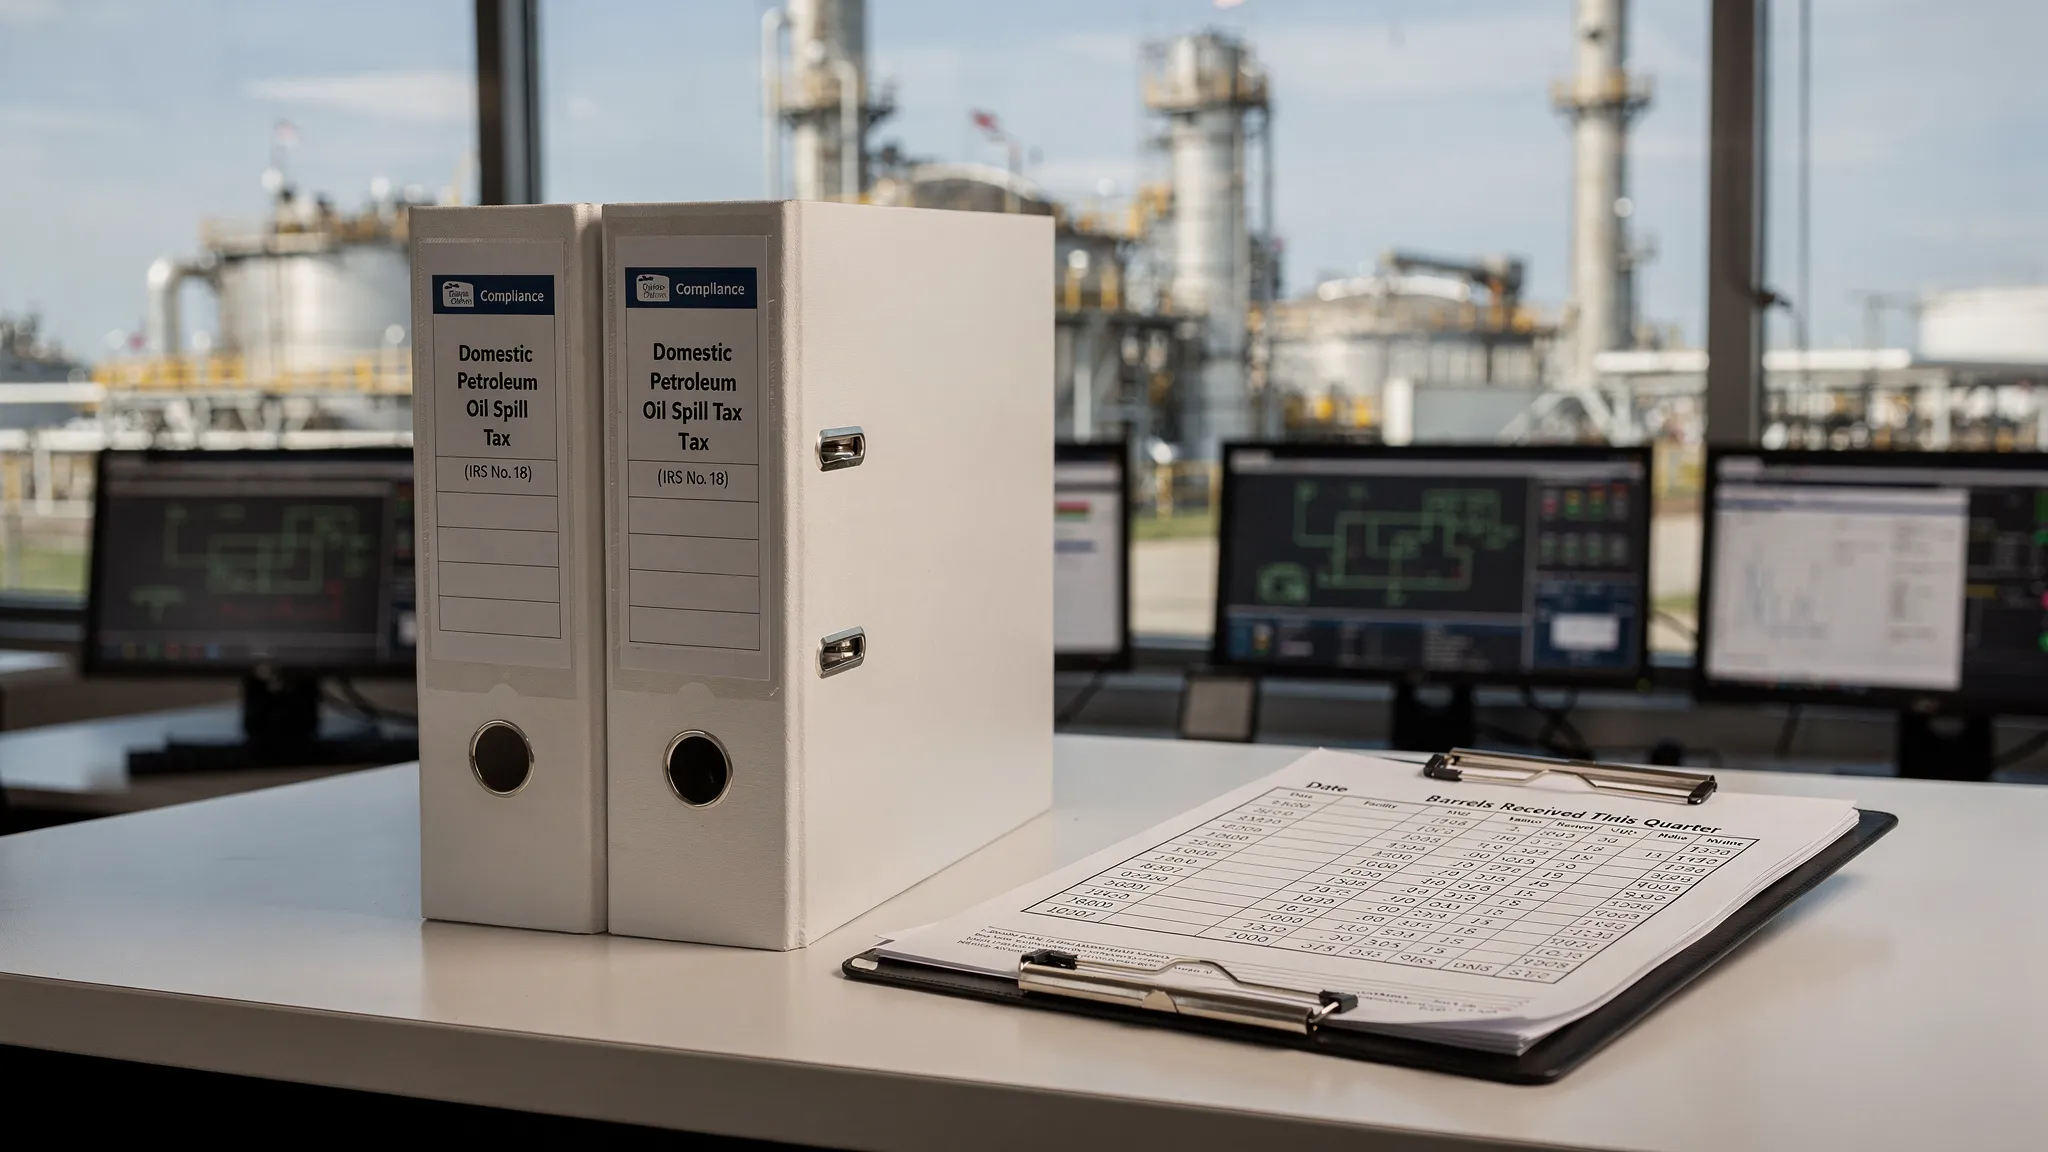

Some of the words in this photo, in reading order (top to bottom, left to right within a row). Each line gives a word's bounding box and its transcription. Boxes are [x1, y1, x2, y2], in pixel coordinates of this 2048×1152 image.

[480, 289, 544, 305] Compliance
[675, 282, 745, 298] Compliance
[458, 343, 533, 363] Domestic
[653, 341, 733, 362] Domestic
[457, 371, 538, 391] Petroleum
[650, 371, 737, 392] Petroleum
[466, 399, 489, 418] Oil
[493, 399, 528, 423] Spill
[642, 400, 666, 420] Oil
[671, 400, 709, 425] Spill
[712, 402, 743, 422] Tax
[483, 428, 512, 447] Tax
[677, 432, 710, 451] Tax
[464, 463, 488, 482] (IRS
[491, 464, 512, 479] No.
[513, 464, 533, 483] 18)
[657, 468, 682, 488] (IRS
[686, 470, 707, 485] No.
[709, 470, 730, 489] 18)
[1306, 780, 1349, 793] Date
[1425, 794, 1495, 809] Barrels
[1499, 802, 1587, 819] Received
[1643, 818, 1722, 834] Quarter
